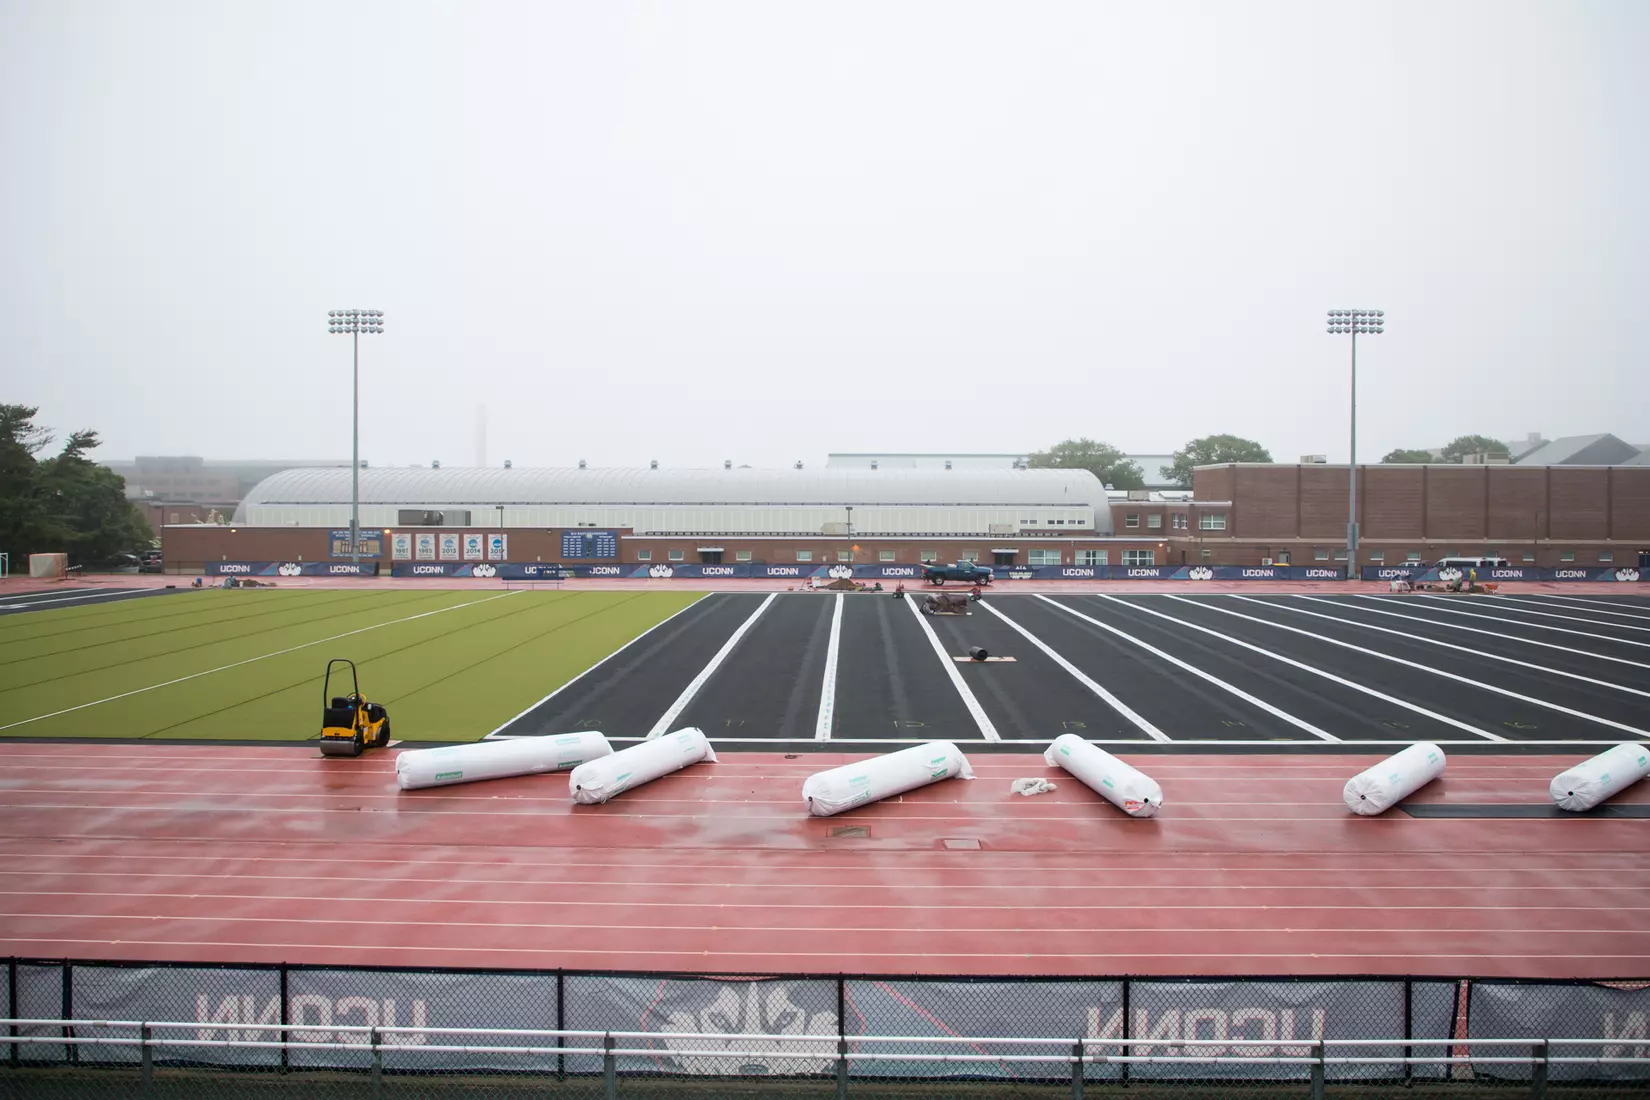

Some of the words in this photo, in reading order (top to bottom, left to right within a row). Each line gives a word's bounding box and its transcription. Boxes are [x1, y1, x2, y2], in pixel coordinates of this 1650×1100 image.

[329, 565, 360, 573] UCONN
[702, 567, 734, 575] UCONN
[767, 567, 799, 575] UCONN
[882, 568, 914, 576] UCONN
[1062, 568, 1094, 576] UCONN
[1128, 568, 1160, 576] UCONN
[1242, 569, 1274, 577] UCONN
[1306, 569, 1338, 577] UCONN
[1491, 570, 1523, 578] UCONN
[1555, 570, 1586, 578] UCONN
